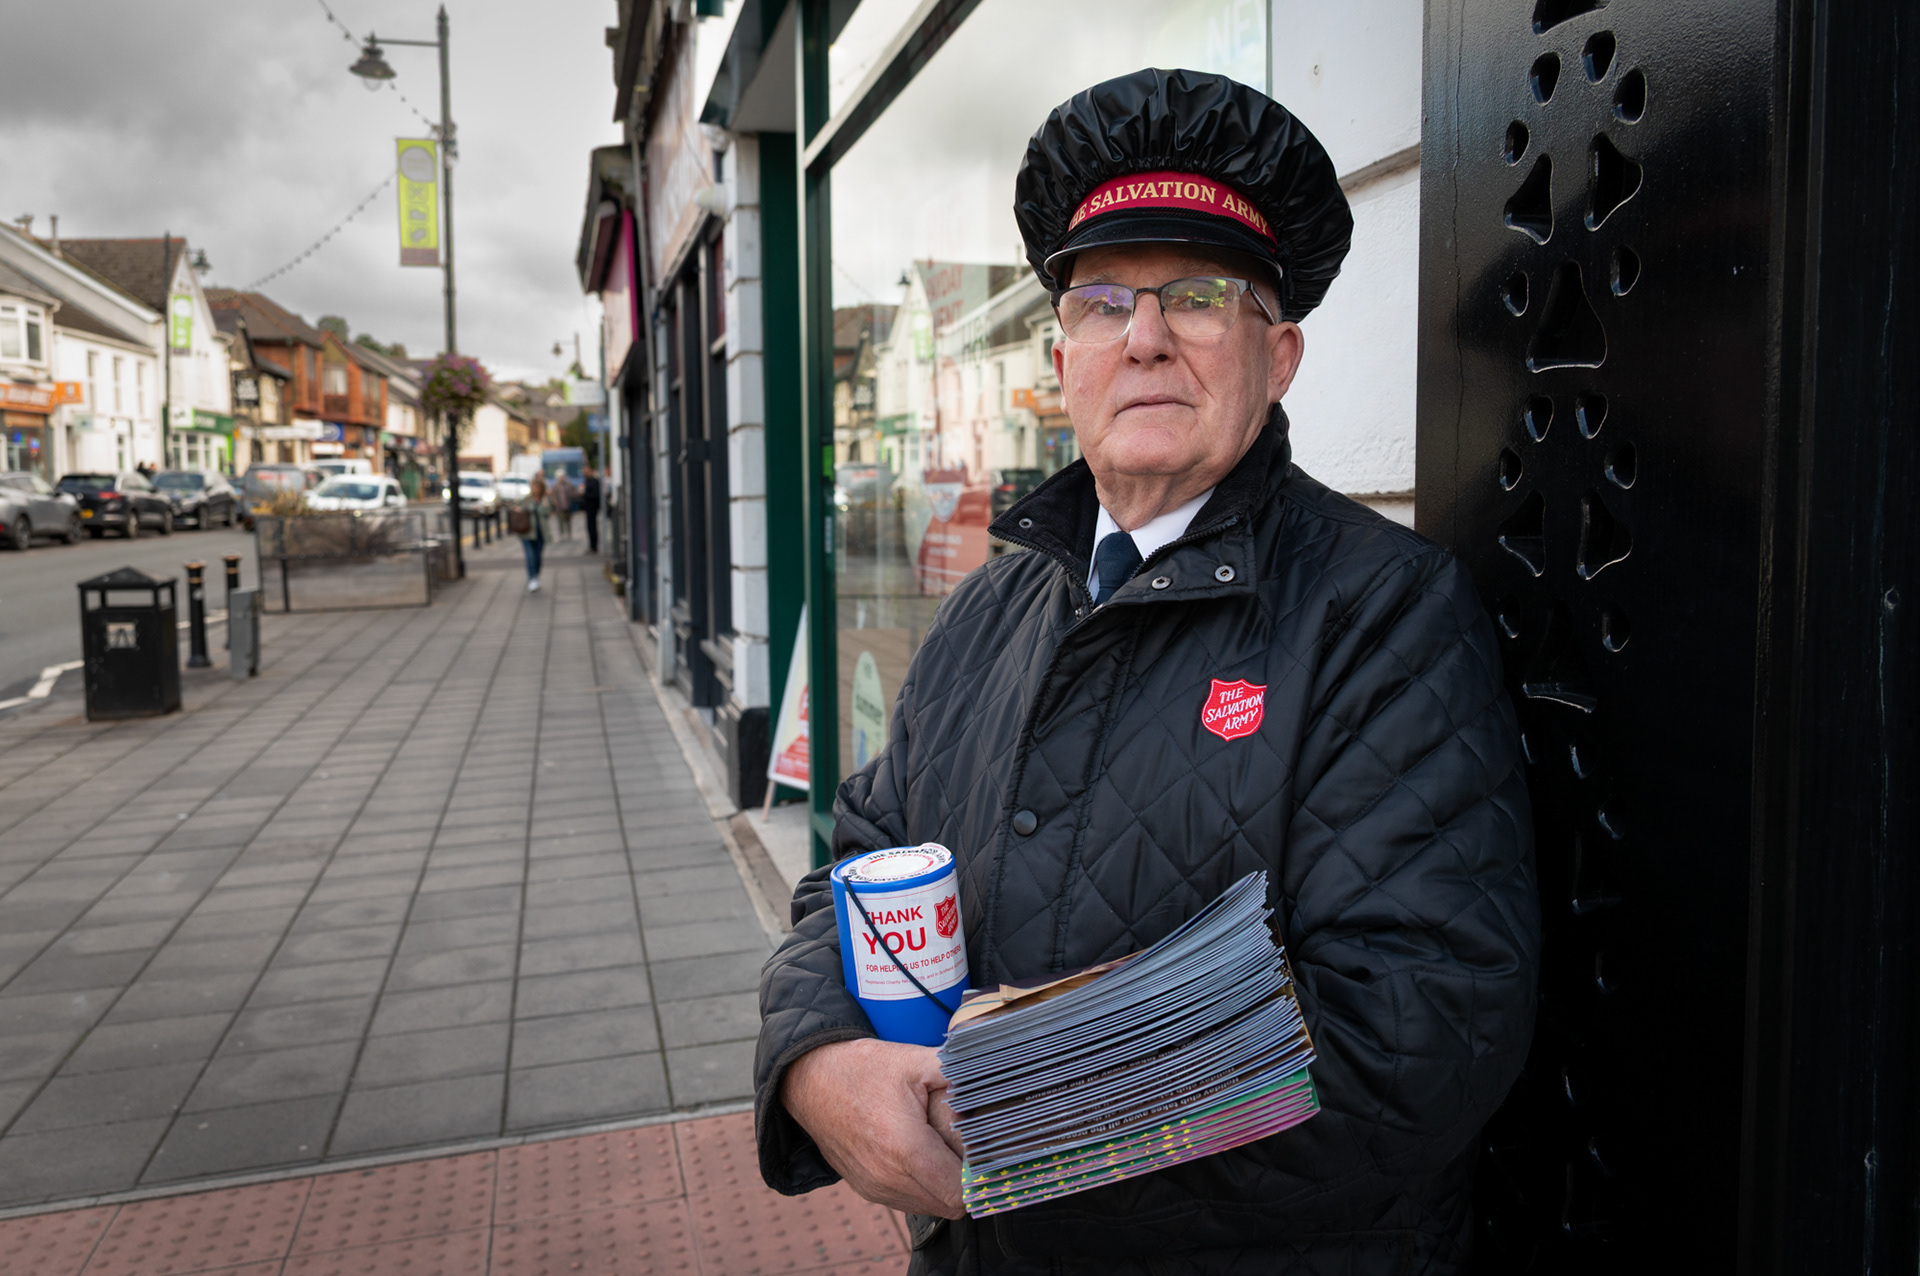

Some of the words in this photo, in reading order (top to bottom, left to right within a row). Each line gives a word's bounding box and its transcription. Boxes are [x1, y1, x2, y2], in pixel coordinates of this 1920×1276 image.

[1089, 181, 1217, 214] SALVATION
[1221, 193, 1269, 236] ARMY
[1219, 687, 1244, 704] THE
[1205, 691, 1263, 723] SALVATION
[1222, 708, 1258, 732] ARMY
[862, 926, 927, 955] YOU
[866, 964, 879, 973] FOR
[879, 963, 909, 973] HELPIG
[909, 961, 920, 970] US
[920, 959, 930, 968] TO
[930, 953, 945, 965] HELP
[945, 943, 962, 959] OTHERS
[1100, 1064, 1127, 1077] away
[1069, 1079, 1085, 1087] the
[1086, 1074, 1099, 1083] all
[1203, 1076, 1240, 1096] Holiday
[1024, 1084, 1068, 1101] pressure
[1180, 1093, 1202, 1105] club
[1150, 1103, 1179, 1114] takes
[1108, 1120, 1122, 1130] all
[1122, 1111, 1149, 1125] away
[1090, 1125, 1107, 1134] the
